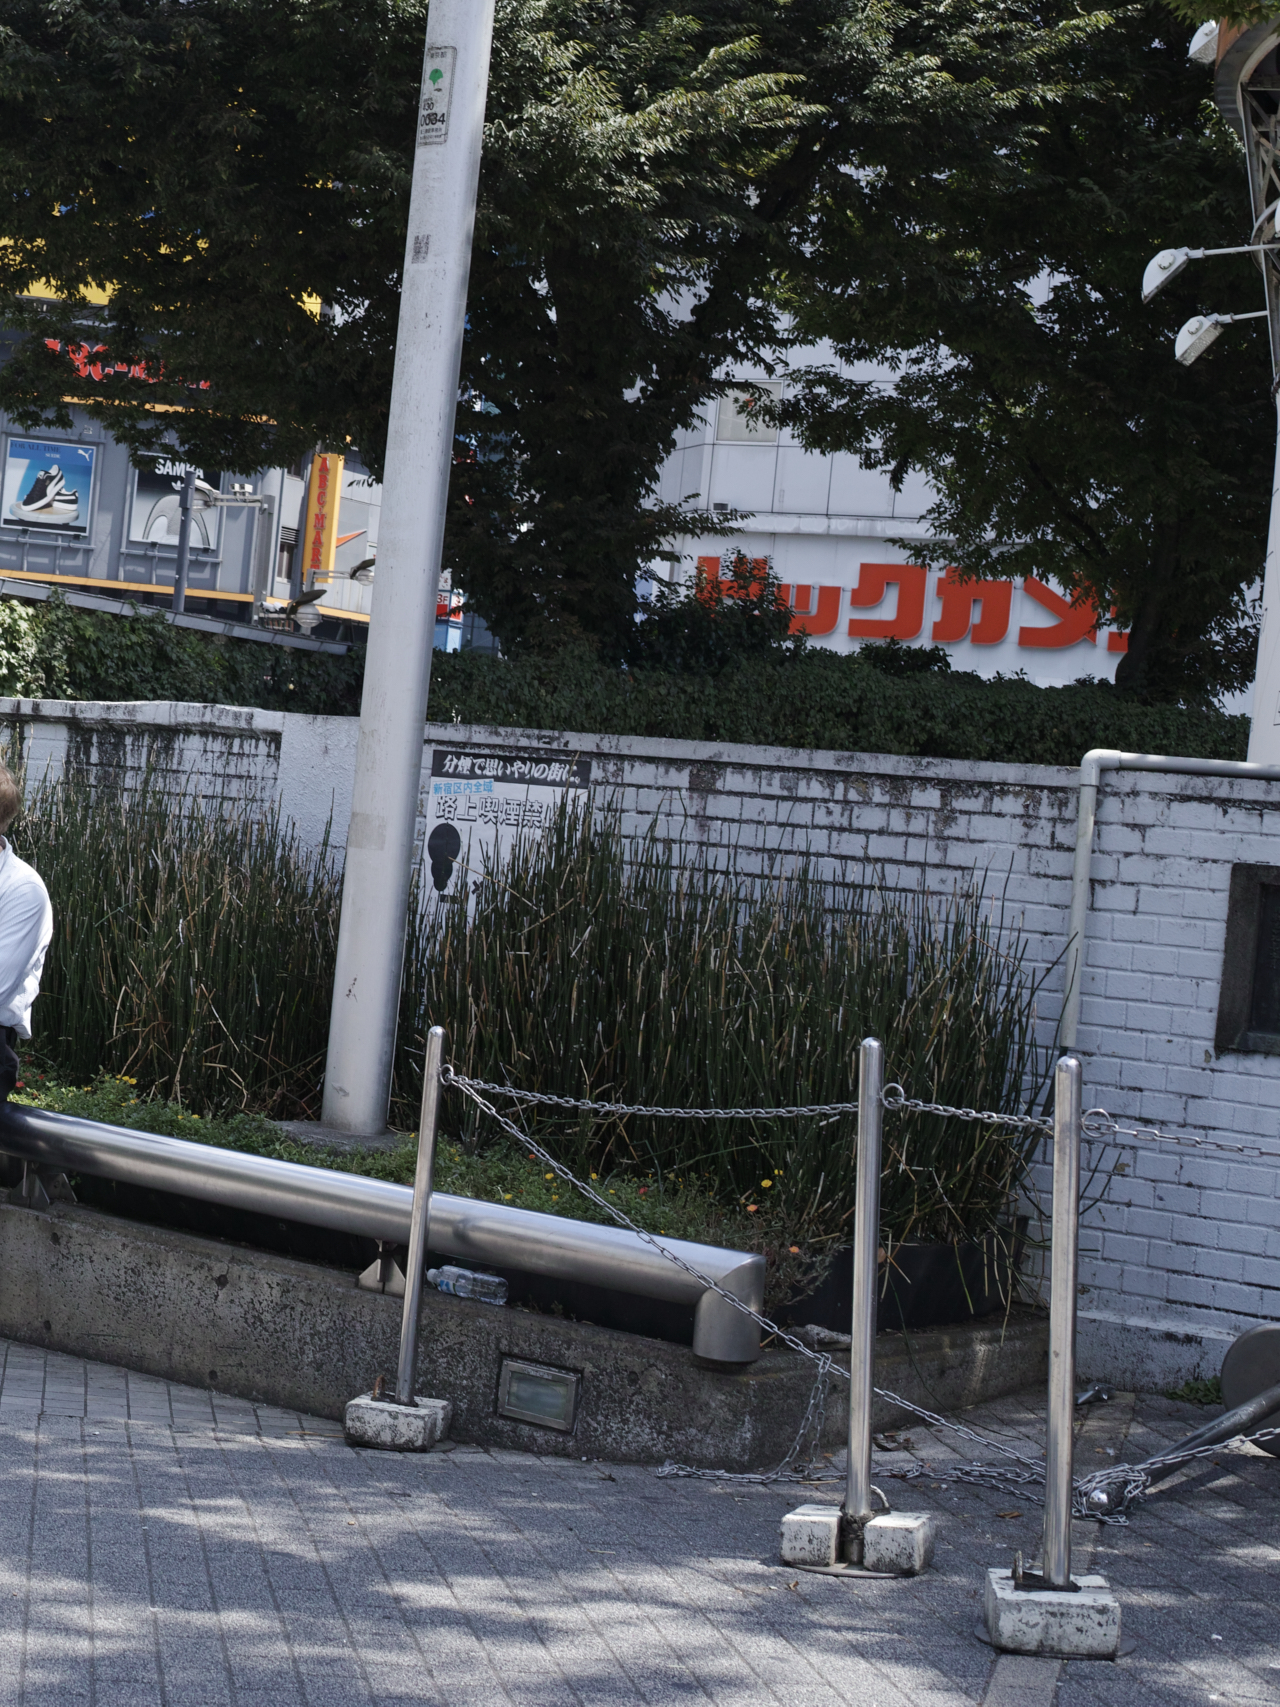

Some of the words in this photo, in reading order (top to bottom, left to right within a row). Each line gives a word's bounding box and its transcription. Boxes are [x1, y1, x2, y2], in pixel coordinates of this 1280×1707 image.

[10, 441, 26, 449] FOR
[28, 443, 42, 451] ALL
[695, 555, 1129, 653] ックカメ
[442, 754, 581, 784] 分煙で思いやりの街に。
[433, 780, 494, 795] 新宿区内全域
